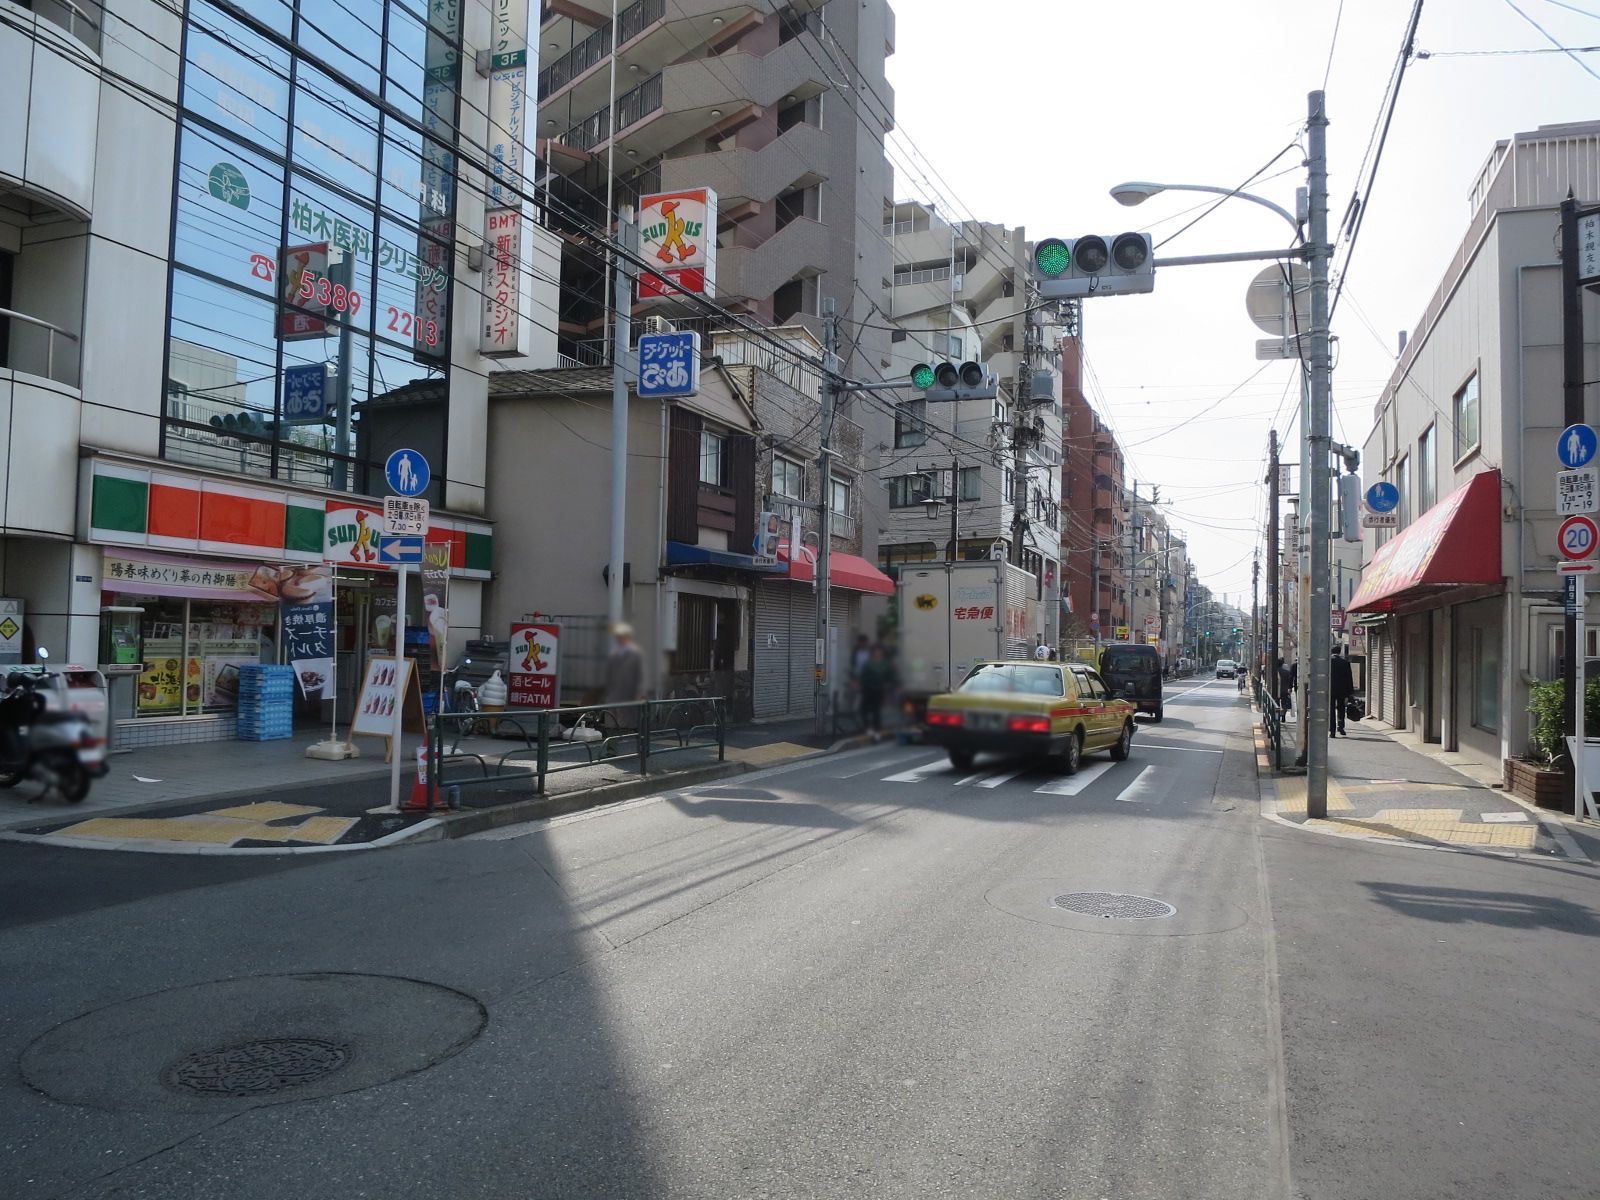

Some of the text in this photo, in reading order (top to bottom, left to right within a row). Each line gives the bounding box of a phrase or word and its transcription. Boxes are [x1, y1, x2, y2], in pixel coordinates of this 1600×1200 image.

[501, 53, 518, 66] 3F
[489, 213, 518, 230] BMT
[494, 234, 511, 345] 新宿スタジオ
[299, 270, 438, 345] 5389 2213
[643, 340, 691, 361] チケット
[642, 360, 689, 389] ぴあ
[1567, 528, 1589, 548] 20
[954, 606, 994, 620] 宅急便
